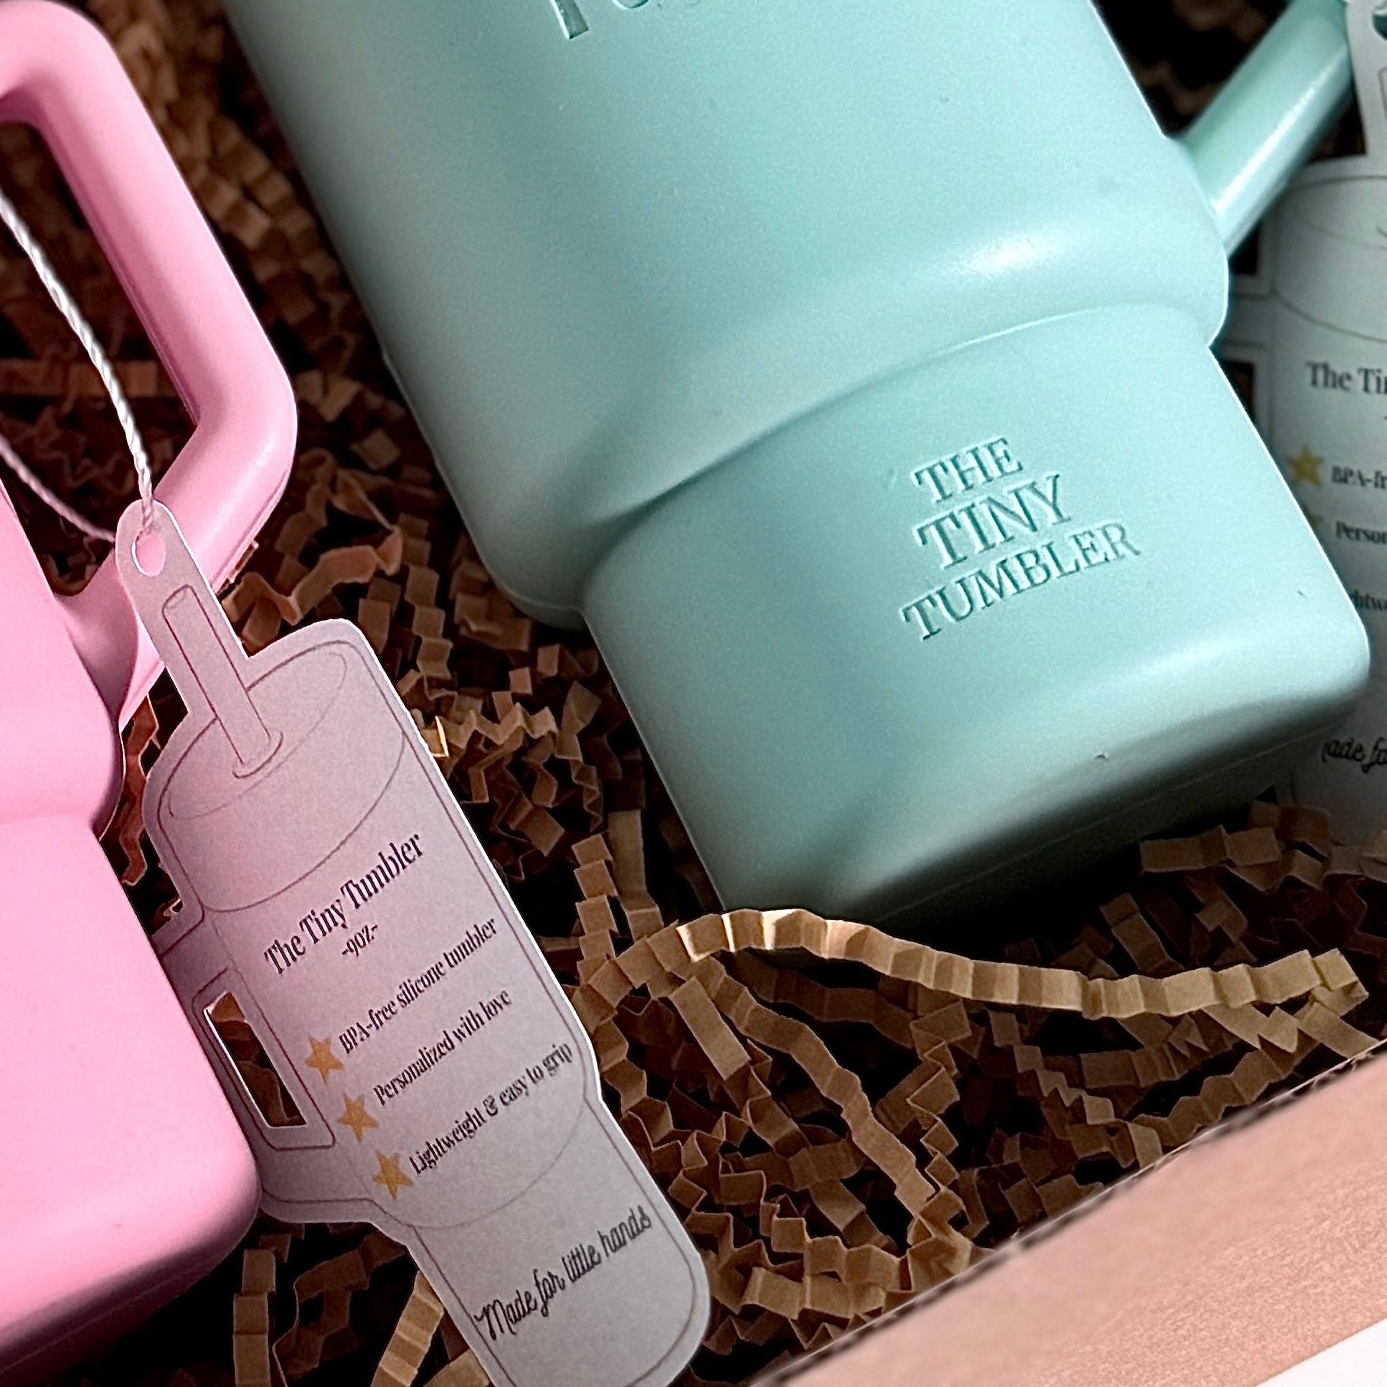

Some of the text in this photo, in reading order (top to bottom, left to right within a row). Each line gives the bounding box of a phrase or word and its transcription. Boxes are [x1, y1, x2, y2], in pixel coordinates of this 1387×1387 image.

[1306, 362, 1387, 395] The Ti
[911, 437, 1023, 504] THE
[913, 473, 1072, 570] TINY
[1331, 465, 1387, 489] BPA-fr
[900, 521, 1141, 641] TUMBLER
[1322, 737, 1365, 763] ade
[263, 834, 423, 975] The Tiny Tumbler
[338, 918, 498, 1054] BPA-free silicone tumbler
[373, 990, 513, 1105] Personalized with love
[409, 1042, 574, 1174] Lightweight & easy to grip
[473, 1204, 652, 1341] Made for little hands
